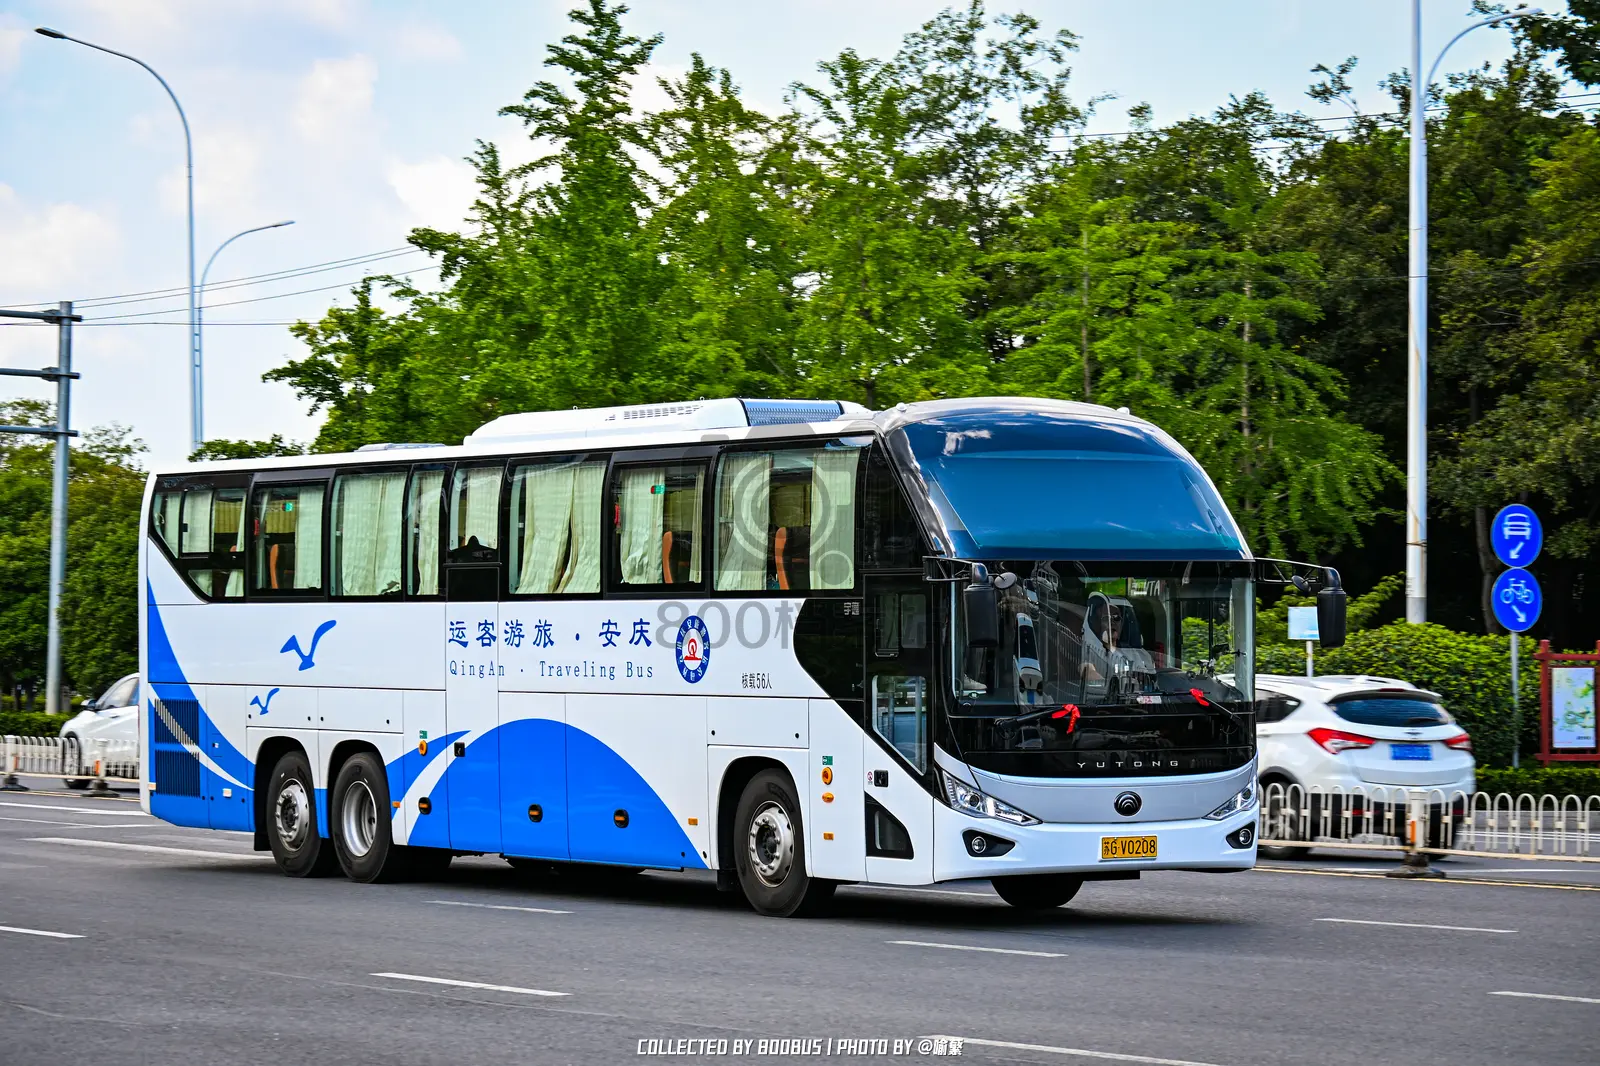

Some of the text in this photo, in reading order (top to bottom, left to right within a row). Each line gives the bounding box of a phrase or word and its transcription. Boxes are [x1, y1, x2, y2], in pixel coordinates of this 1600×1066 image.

[449, 660, 505, 679] QingAn
[540, 660, 616, 680] Traveling
[626, 661, 653, 678] Bus
[741, 672, 773, 689] 核载56人
[1077, 760, 1178, 768] YUTONG
